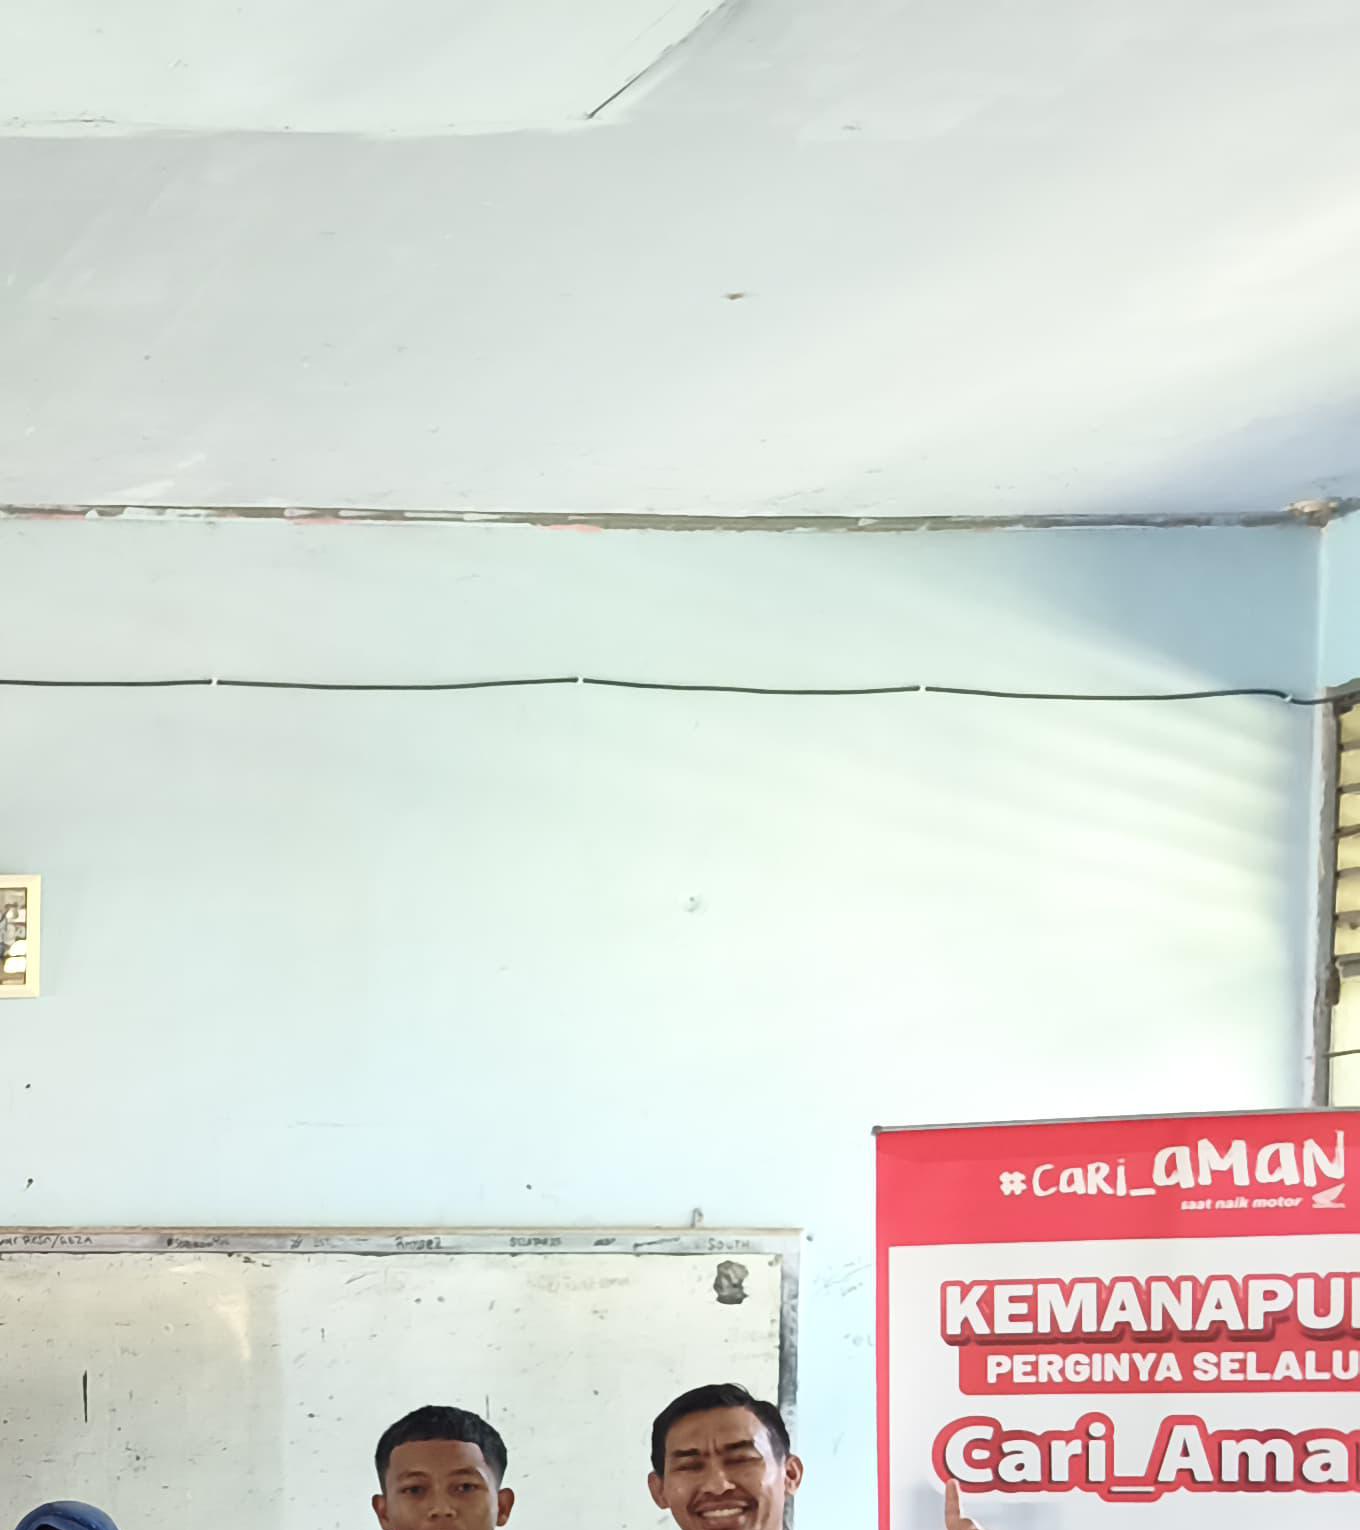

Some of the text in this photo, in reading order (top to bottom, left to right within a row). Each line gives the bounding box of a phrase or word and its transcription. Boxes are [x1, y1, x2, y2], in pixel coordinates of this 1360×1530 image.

[1181, 1195, 1303, 1211] saat naik motor
[945, 1277, 1360, 1335] KEMANAPU
[987, 1350, 1360, 1384] PERGINYA SELALU
